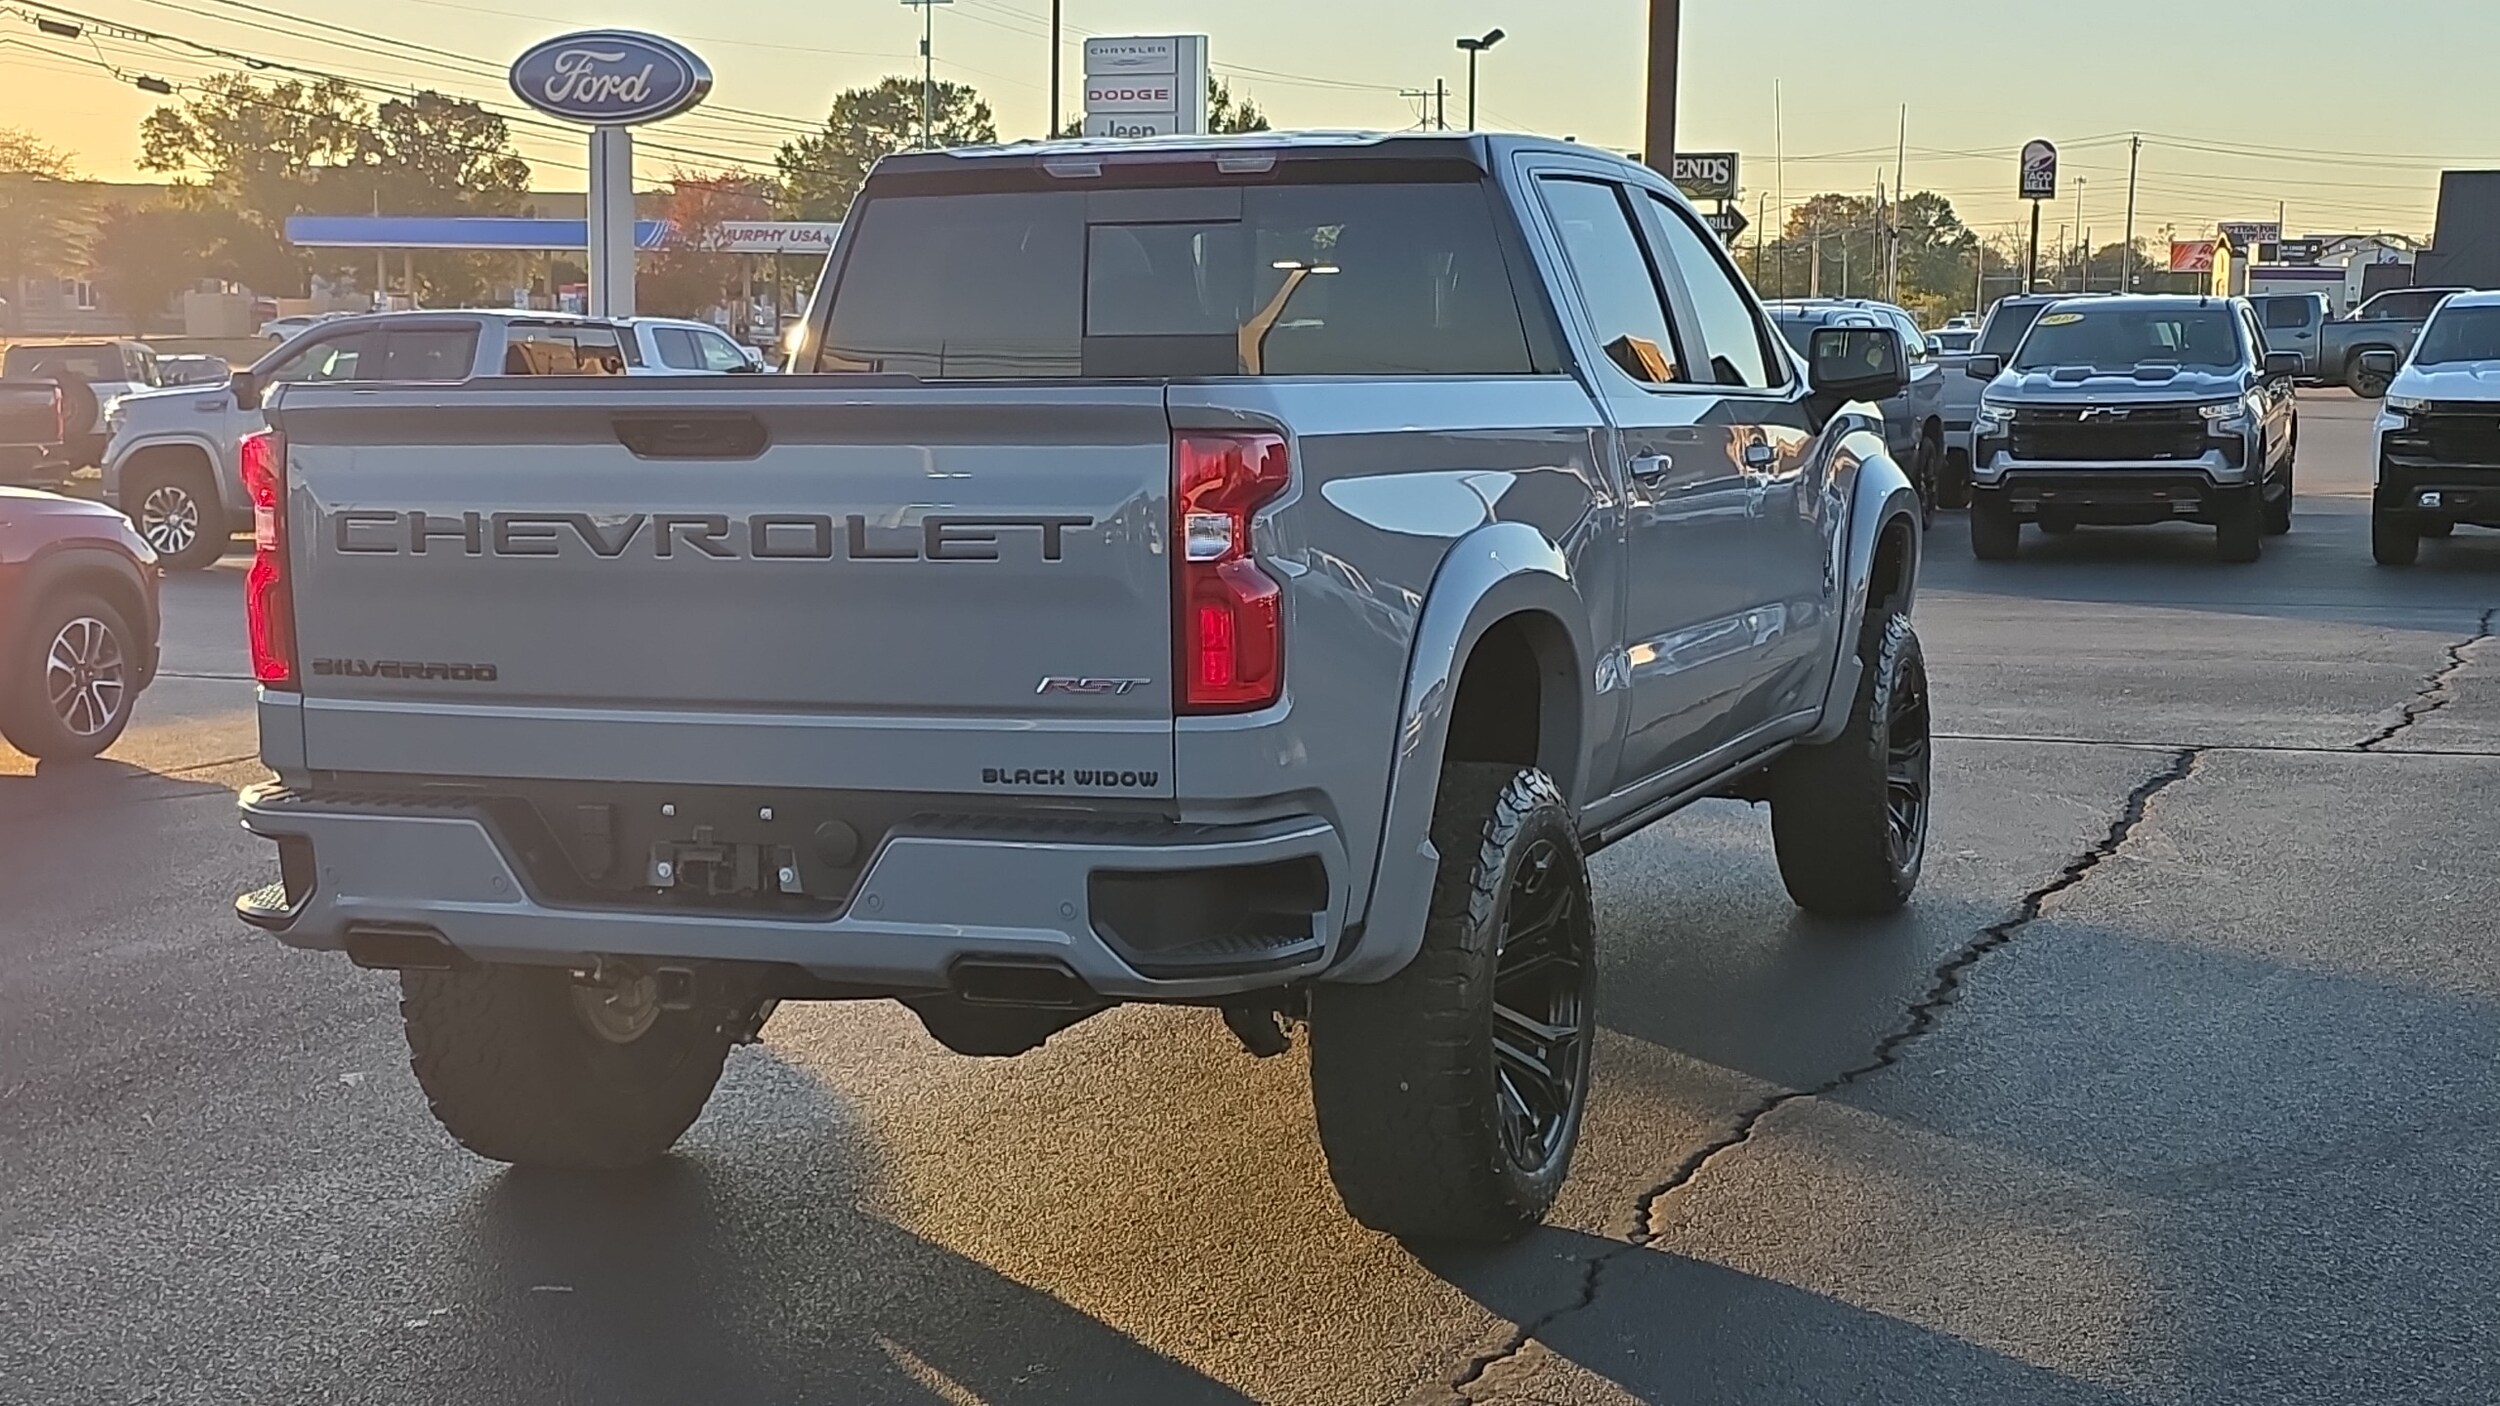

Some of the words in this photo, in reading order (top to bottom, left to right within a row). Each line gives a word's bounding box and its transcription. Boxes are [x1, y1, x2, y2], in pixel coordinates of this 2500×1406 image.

[1090, 46, 1166, 55] CHRYSLER
[545, 50, 653, 103] Ford
[1088, 89, 1168, 101] DODGE
[1673, 158, 1730, 184] ENDS
[2023, 171, 2053, 181] TACO
[2023, 180, 2052, 190] BELL
[1706, 215, 1735, 230] RILL
[720, 229, 786, 242] MURPHY
[789, 229, 822, 242] USA
[335, 510, 1094, 562] CHEVROLET
[312, 657, 498, 681] SILVERADO
[1036, 676, 1151, 695] RST
[982, 768, 1065, 785] BLACK
[1073, 769, 1158, 787] WIDOW
